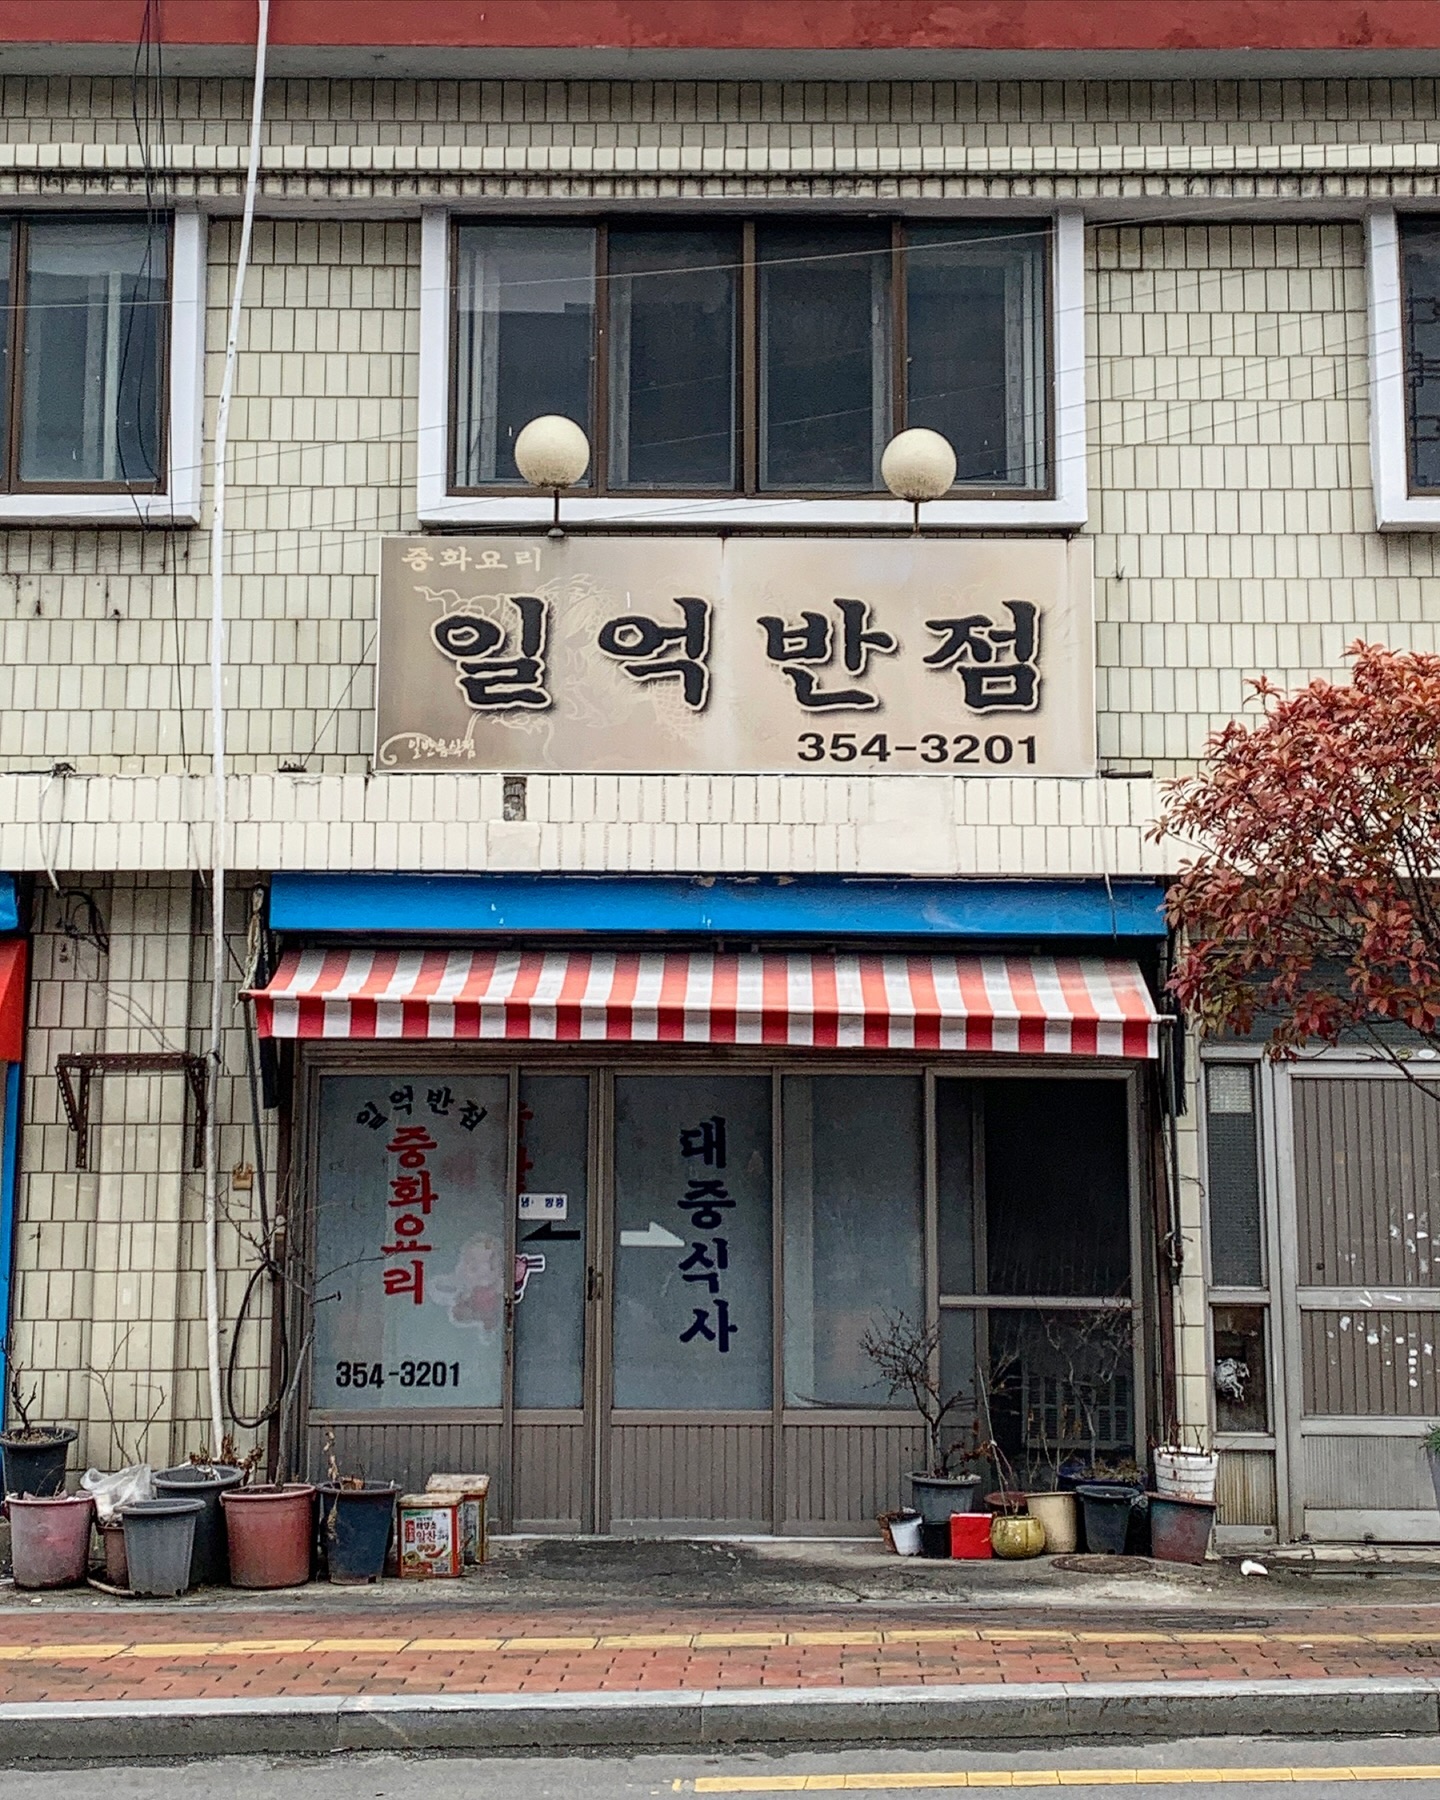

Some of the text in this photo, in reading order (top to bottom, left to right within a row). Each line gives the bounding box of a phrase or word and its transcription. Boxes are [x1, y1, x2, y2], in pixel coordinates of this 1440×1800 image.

[401, 546, 542, 572] 중화요리
[432, 595, 1042, 713] 일억반점
[798, 732, 1037, 764] 354-3201
[356, 1085, 488, 1132] 일억반점
[380, 1126, 439, 1305] 중화요리
[677, 1115, 738, 1353] 대중식사
[335, 1361, 461, 1388] 354-3201
